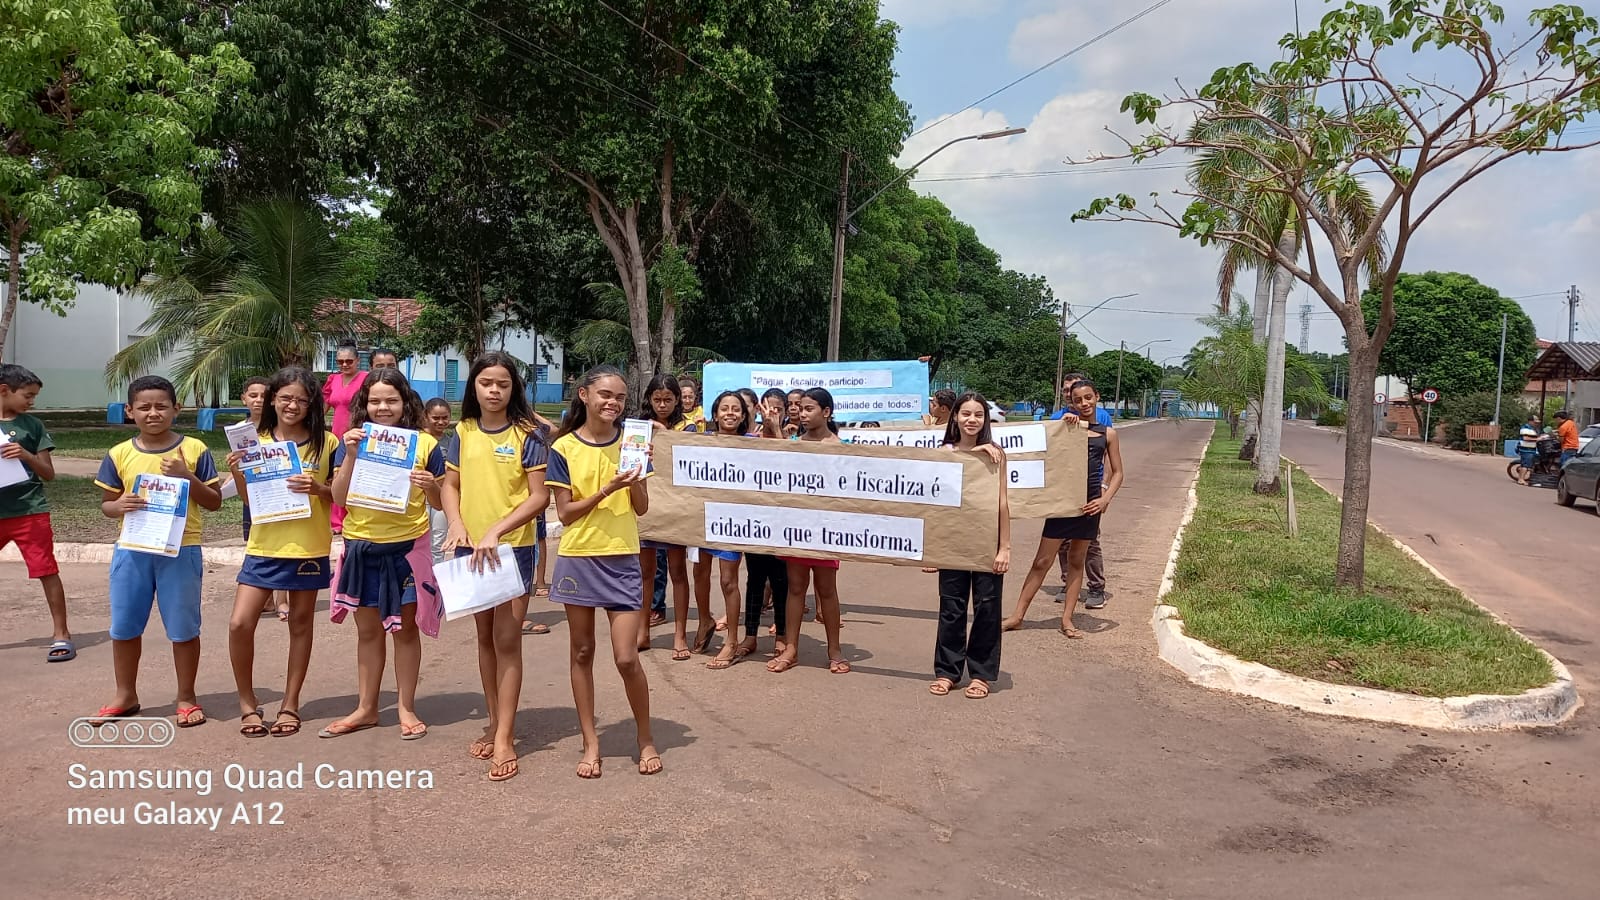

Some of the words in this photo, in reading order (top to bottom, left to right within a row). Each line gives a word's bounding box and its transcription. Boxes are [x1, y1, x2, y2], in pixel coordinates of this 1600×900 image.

[833, 400, 870, 410] abilidade
[872, 400, 884, 409] de
[887, 400, 918, 409] todos."
[1000, 435, 1024, 449] um
[679, 459, 746, 484] "Cidadão
[753, 469, 782, 490] que
[788, 472, 826, 494] paga
[838, 474, 847, 490] e
[856, 470, 925, 497] fiscaliza
[931, 476, 941, 498] é
[1010, 470, 1019, 483] e
[711, 516, 771, 539] cidadão
[783, 525, 812, 546] que
[822, 526, 918, 553] transforma.
